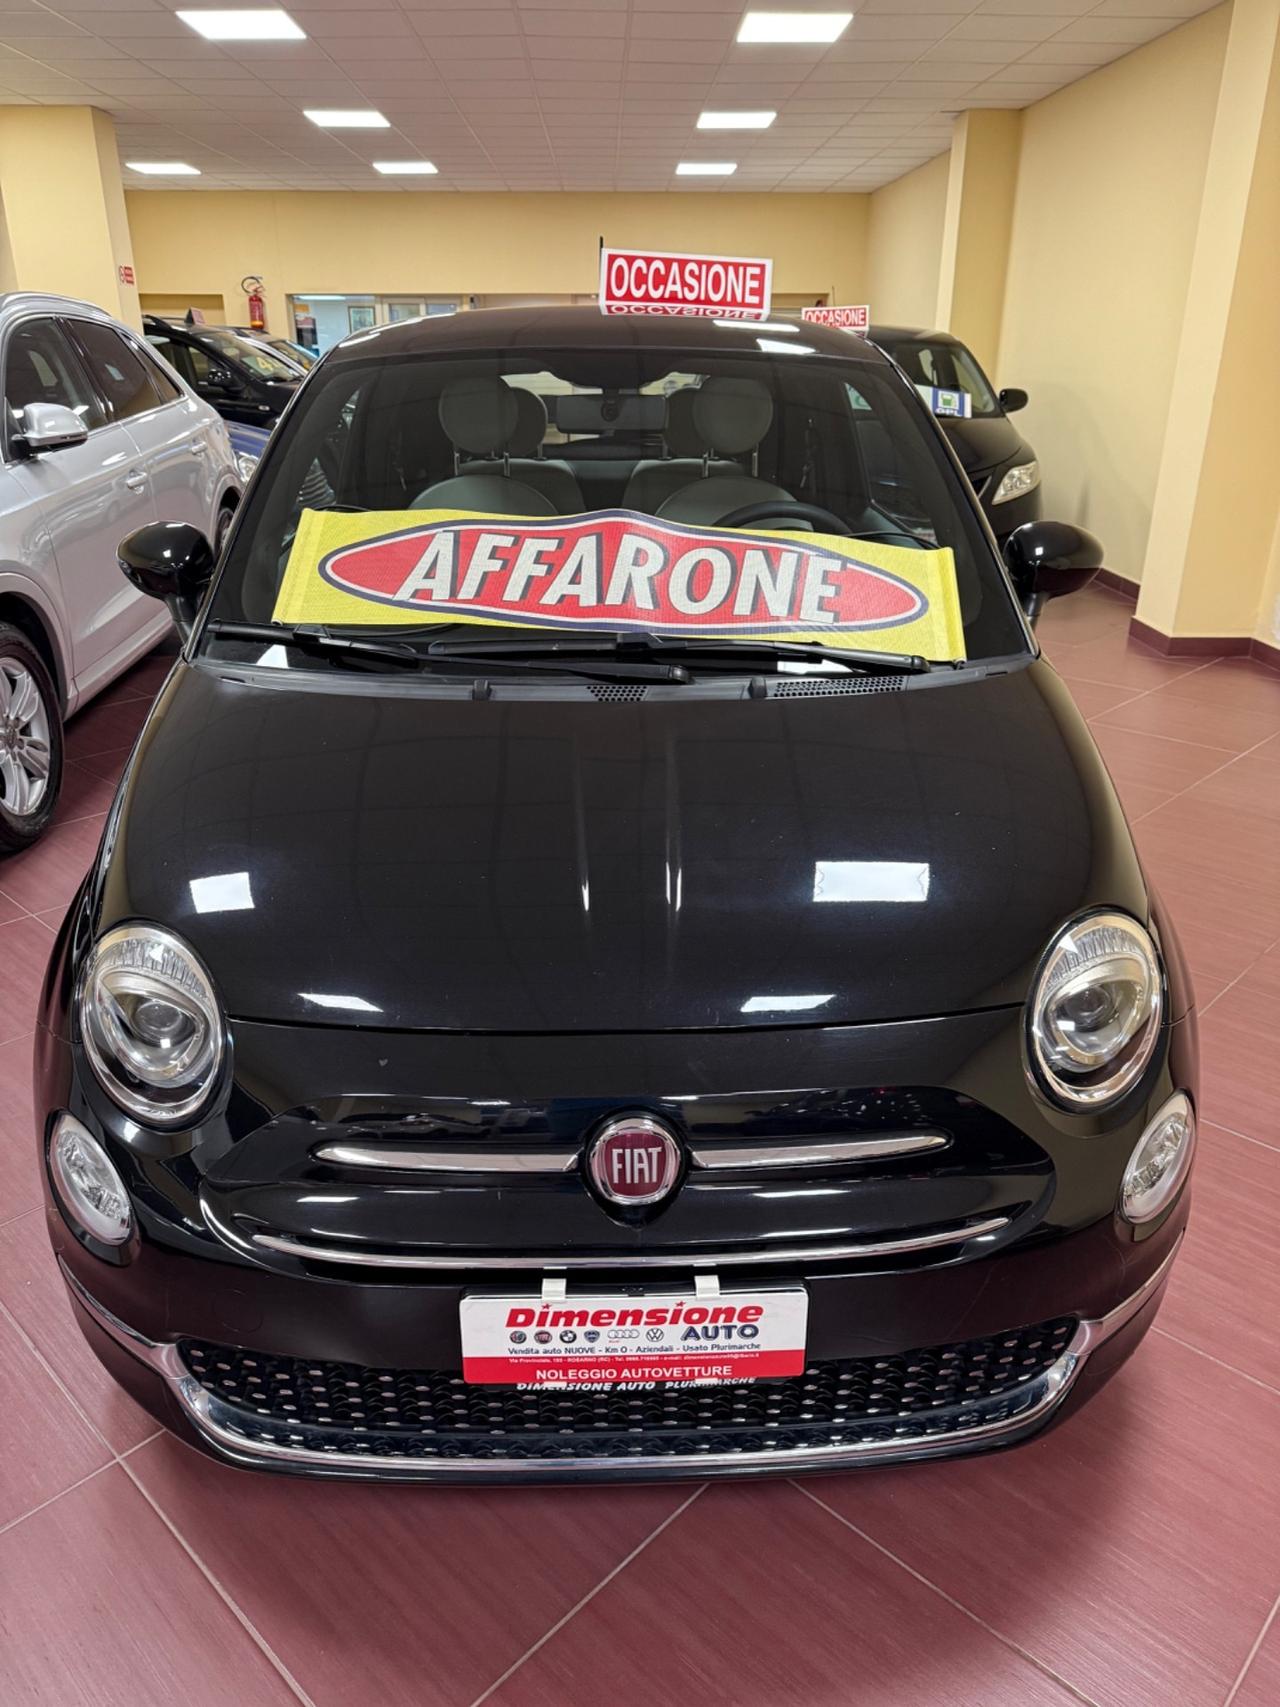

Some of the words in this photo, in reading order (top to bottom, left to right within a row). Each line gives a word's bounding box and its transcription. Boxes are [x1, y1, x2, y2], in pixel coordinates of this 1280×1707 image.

[611, 257, 760, 304] OCCASIONE
[806, 309, 865, 325] OCCASIONE
[393, 530, 845, 623] AFFARONE
[612, 1147, 662, 1184] FIAT
[506, 1302, 764, 1328] Dimensione
[680, 1324, 759, 1341] AUTO
[508, 1347, 539, 1355] Vendita
[565, 1346, 595, 1354] NUOVE
[604, 1346, 618, 1354] Km
[636, 1344, 674, 1353] Aziendali
[682, 1344, 708, 1352] Usato
[711, 1342, 761, 1351] Plurimarche
[536, 1368, 617, 1380] NOLEGGIO
[620, 1365, 732, 1379] AUTOVETTURE
[617, 1381, 655, 1390] AUTO
